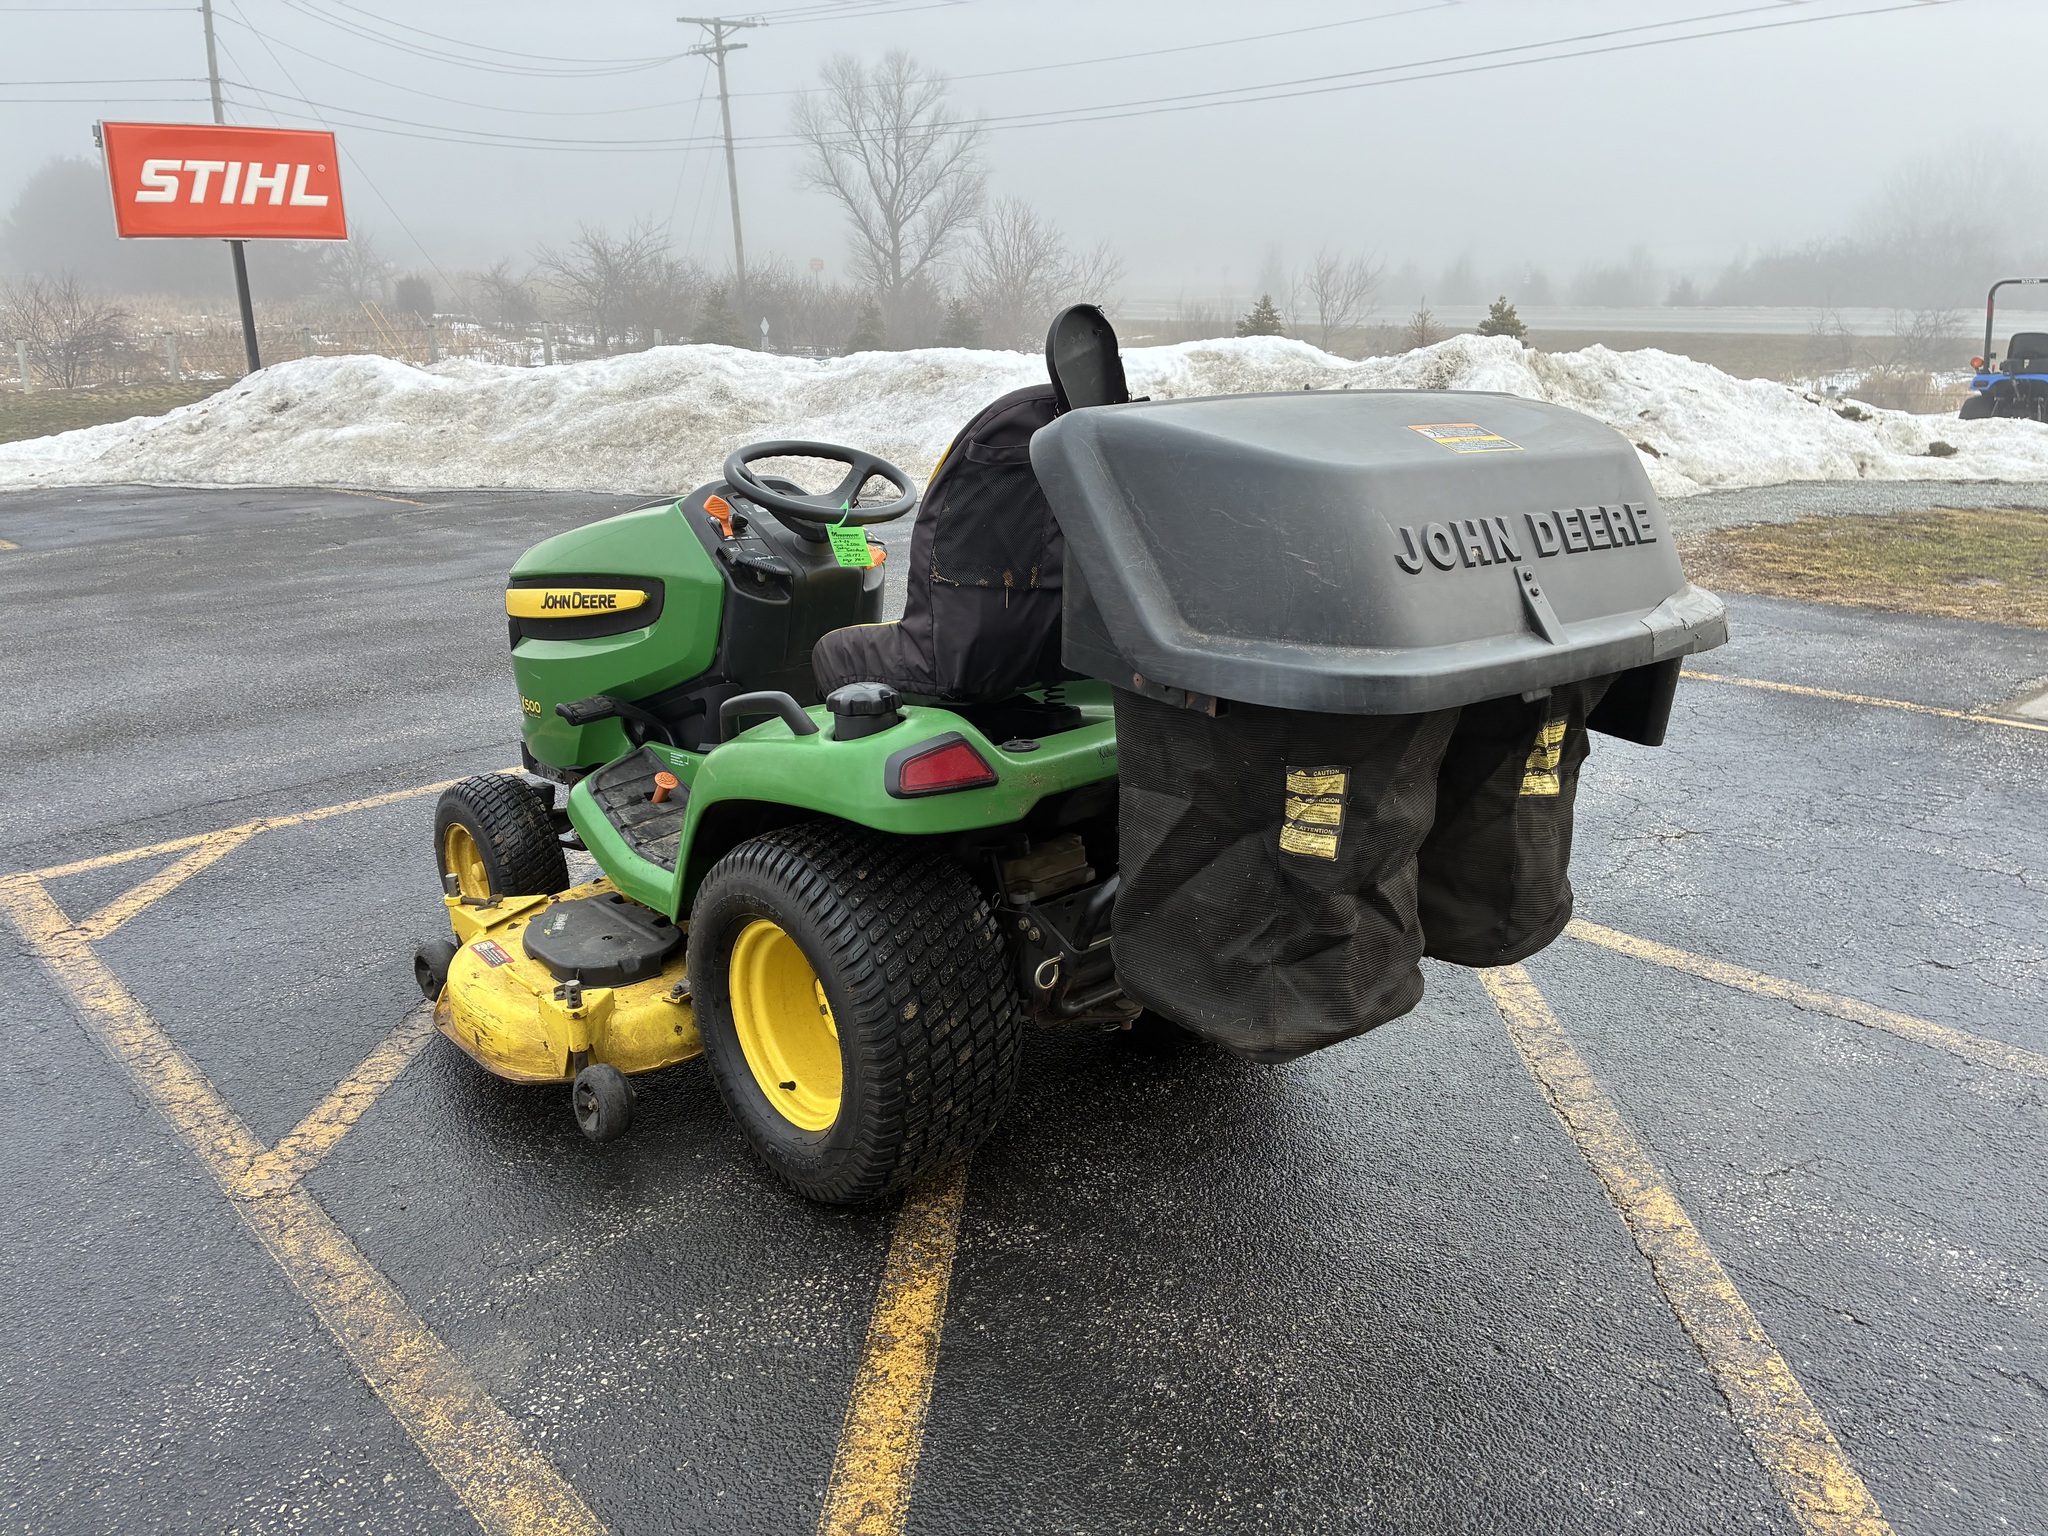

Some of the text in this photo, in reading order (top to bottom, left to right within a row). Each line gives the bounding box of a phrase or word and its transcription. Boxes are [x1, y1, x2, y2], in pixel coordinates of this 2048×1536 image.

[135, 159, 329, 207] STIHL
[1394, 502, 1657, 575] JOHN DEERE
[541, 592, 617, 609] JOHN DEERE
[1313, 769, 1340, 777] CAUTION
[1298, 825, 1334, 835] ATTENTION
